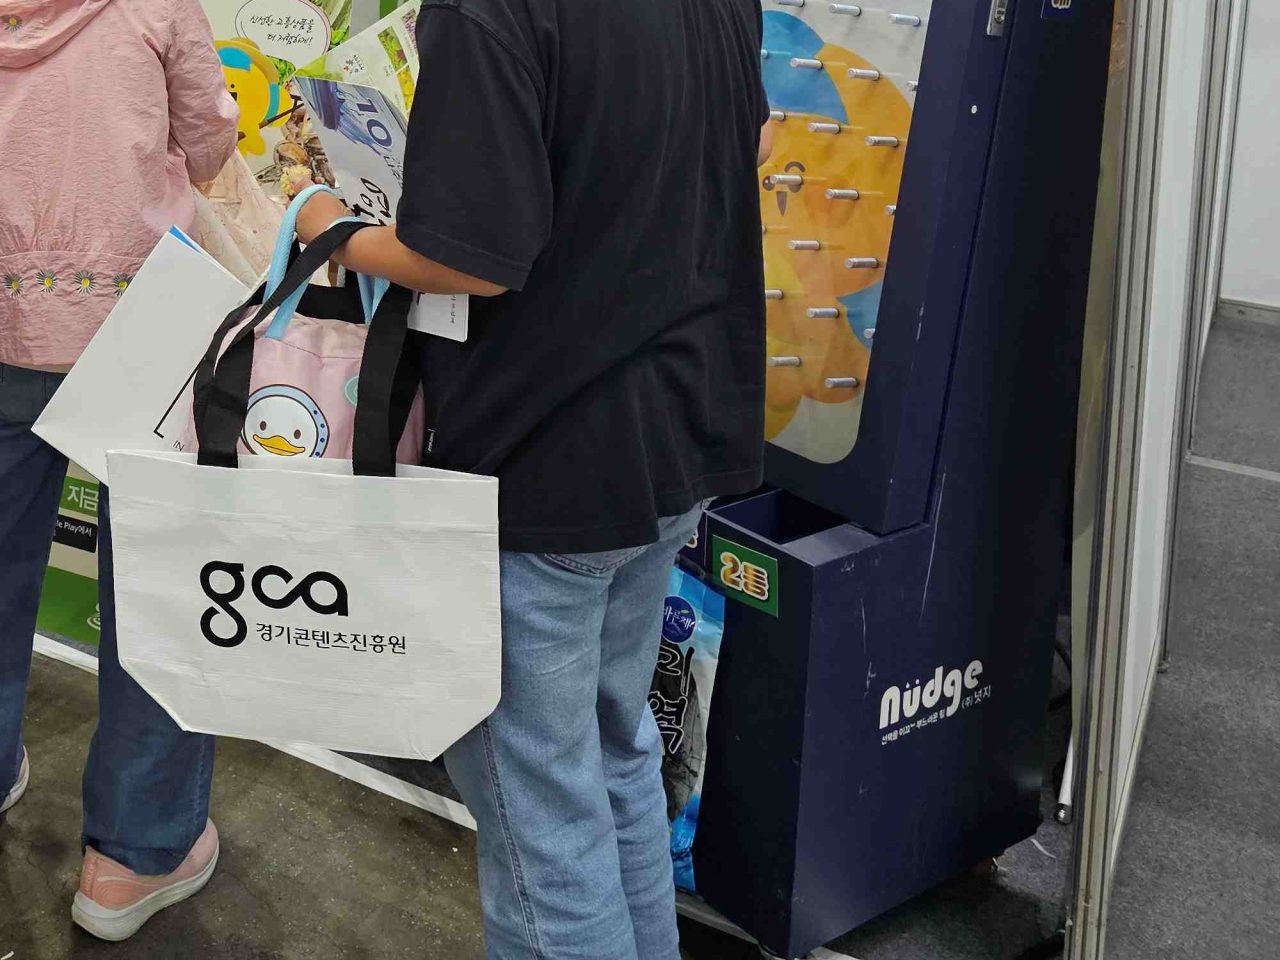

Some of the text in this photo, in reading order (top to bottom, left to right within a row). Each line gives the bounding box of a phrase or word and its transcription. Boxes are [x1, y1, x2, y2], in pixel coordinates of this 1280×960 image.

[67, 485, 99, 512] 지금
[64, 521, 92, 537] Play에서
[720, 551, 769, 600] 2등
[199, 560, 349, 647] gca
[256, 622, 407, 655] 경기콘텐츠진흥원
[881, 729, 899, 746] 선택을
